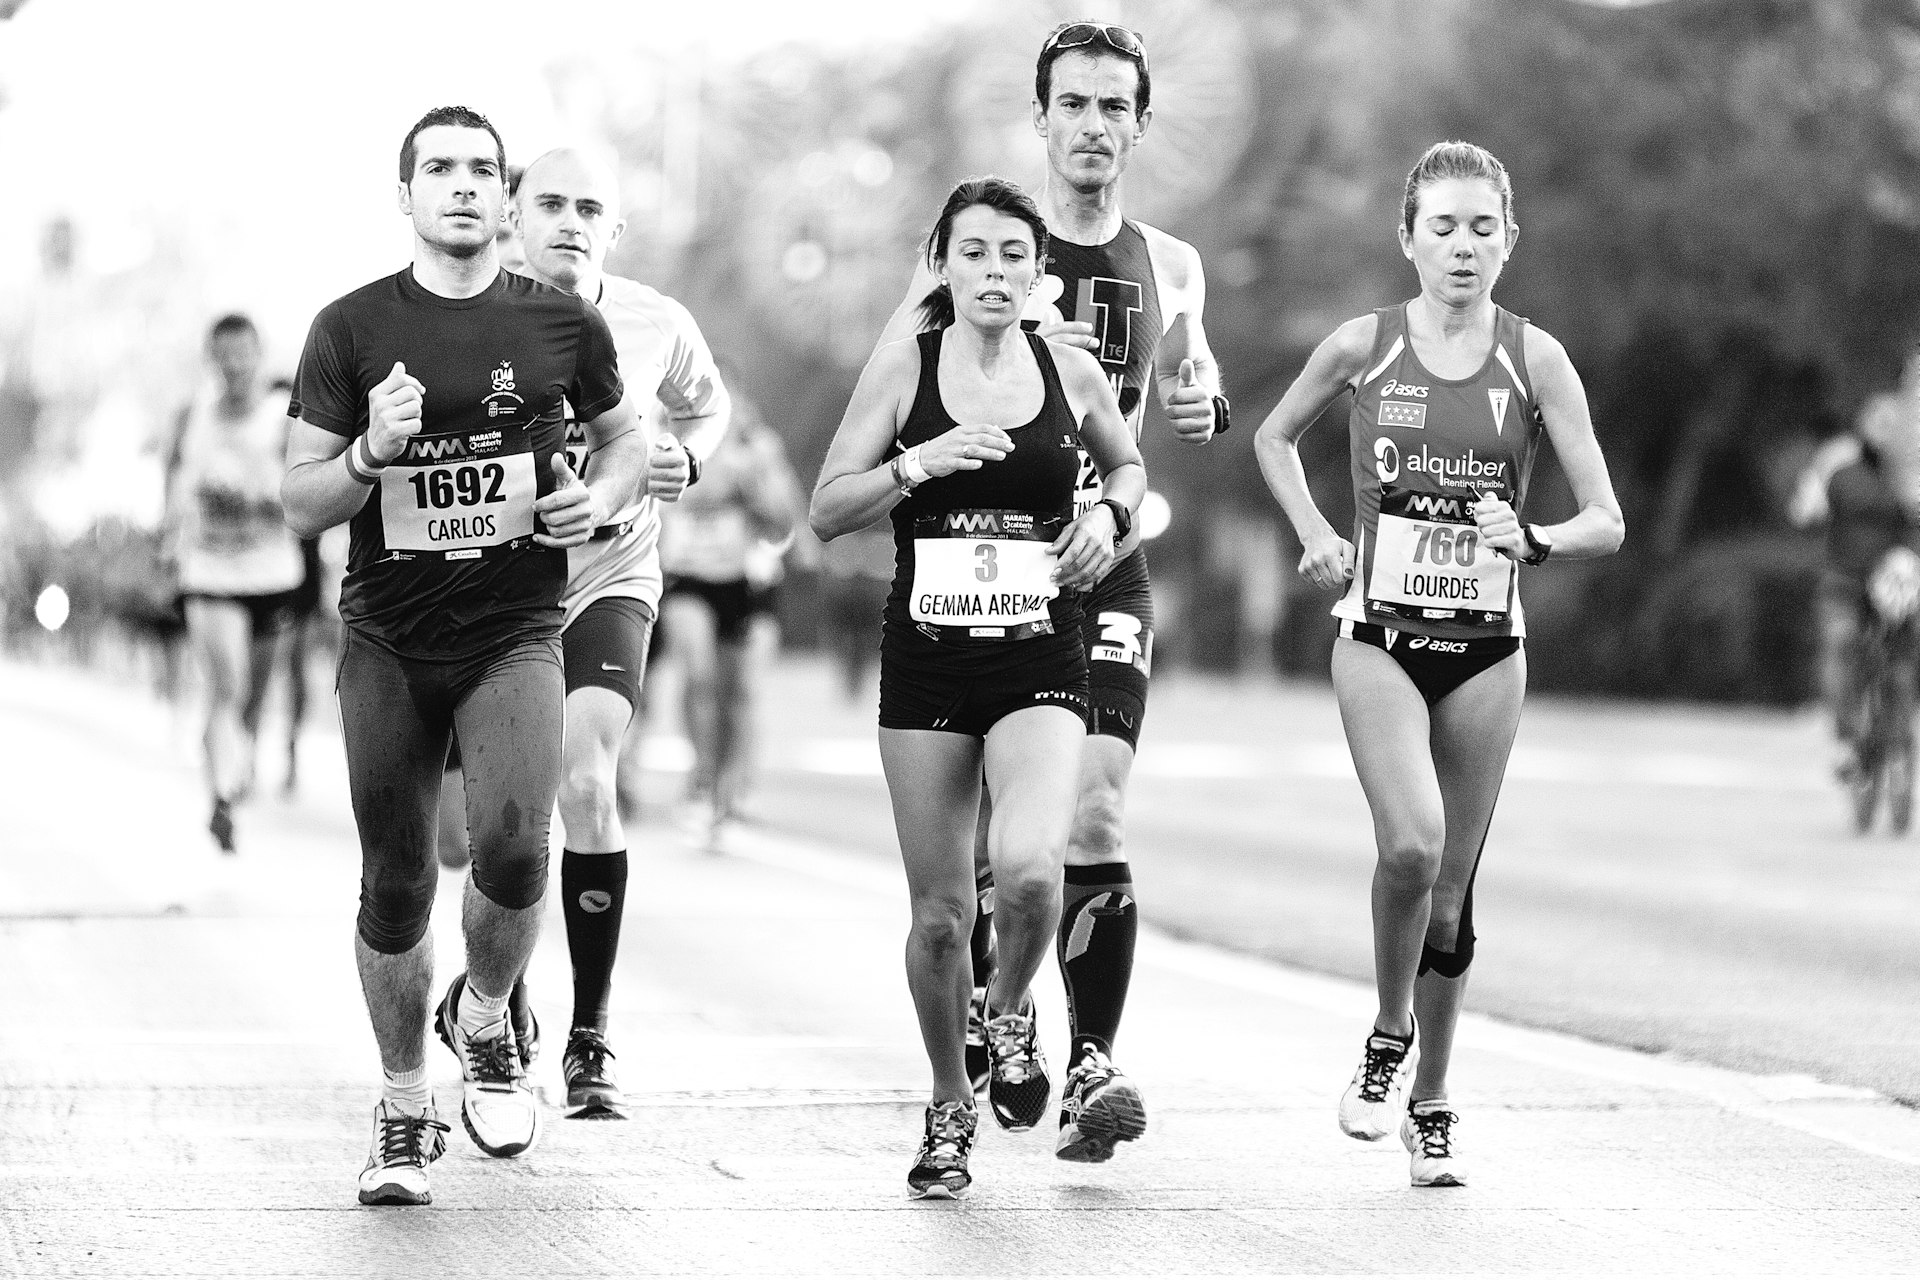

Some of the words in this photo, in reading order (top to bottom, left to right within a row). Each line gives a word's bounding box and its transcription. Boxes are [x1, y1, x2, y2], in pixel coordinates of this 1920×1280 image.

[1407, 444, 1506, 487] alquiber
[408, 463, 507, 509] 1692
[1443, 478, 1475, 489] Renting
[1476, 480, 1505, 489] Flexible
[428, 514, 496, 541] CARLOS
[1412, 525, 1478, 567] 760
[974, 543, 998, 583] 3
[1403, 573, 1479, 600] LOURDES
[919, 594, 983, 616] GEMMA
[1428, 641, 1468, 653] asics
